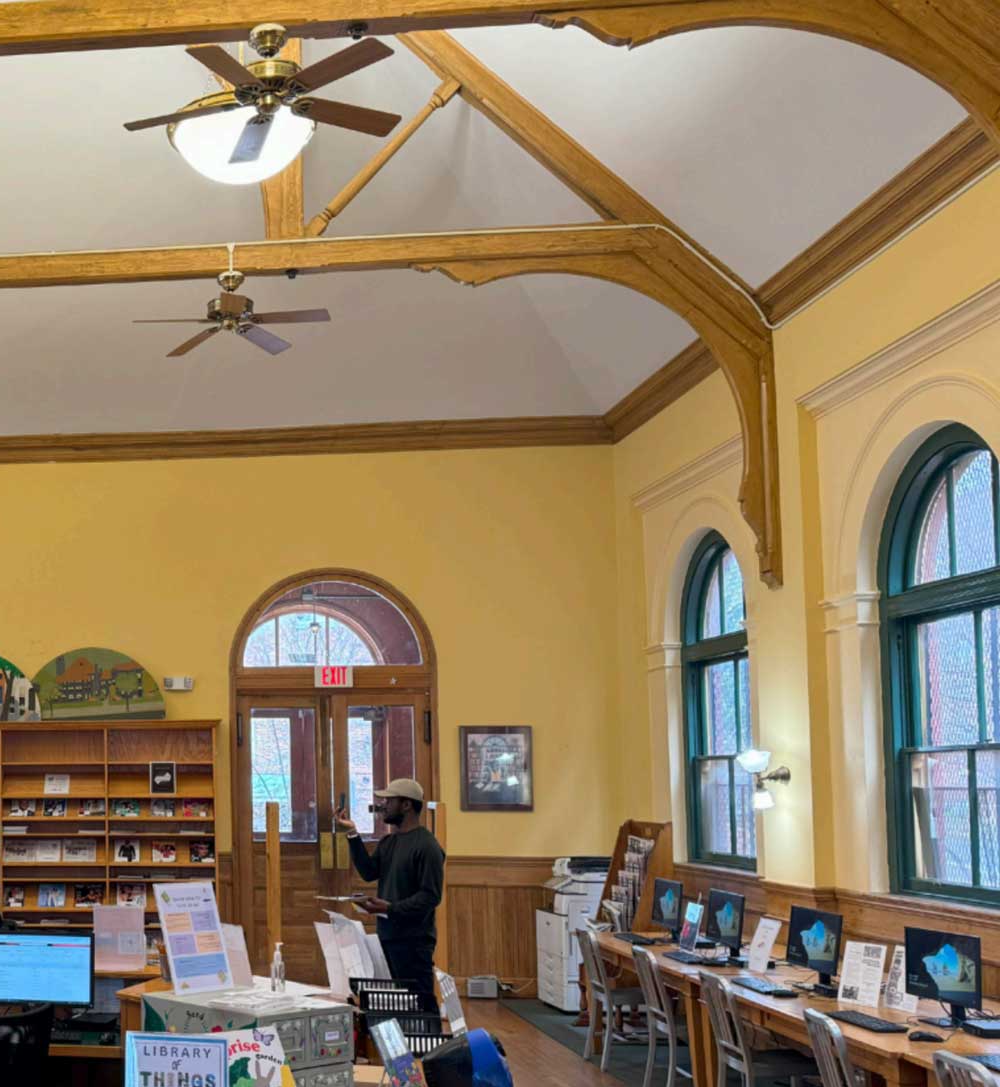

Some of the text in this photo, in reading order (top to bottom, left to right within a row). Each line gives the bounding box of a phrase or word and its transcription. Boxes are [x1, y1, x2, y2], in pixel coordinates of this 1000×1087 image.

[322, 666, 347, 686] EXIT
[143, 1045, 212, 1059] LIBRARY
[255, 1053, 283, 1065] garden
